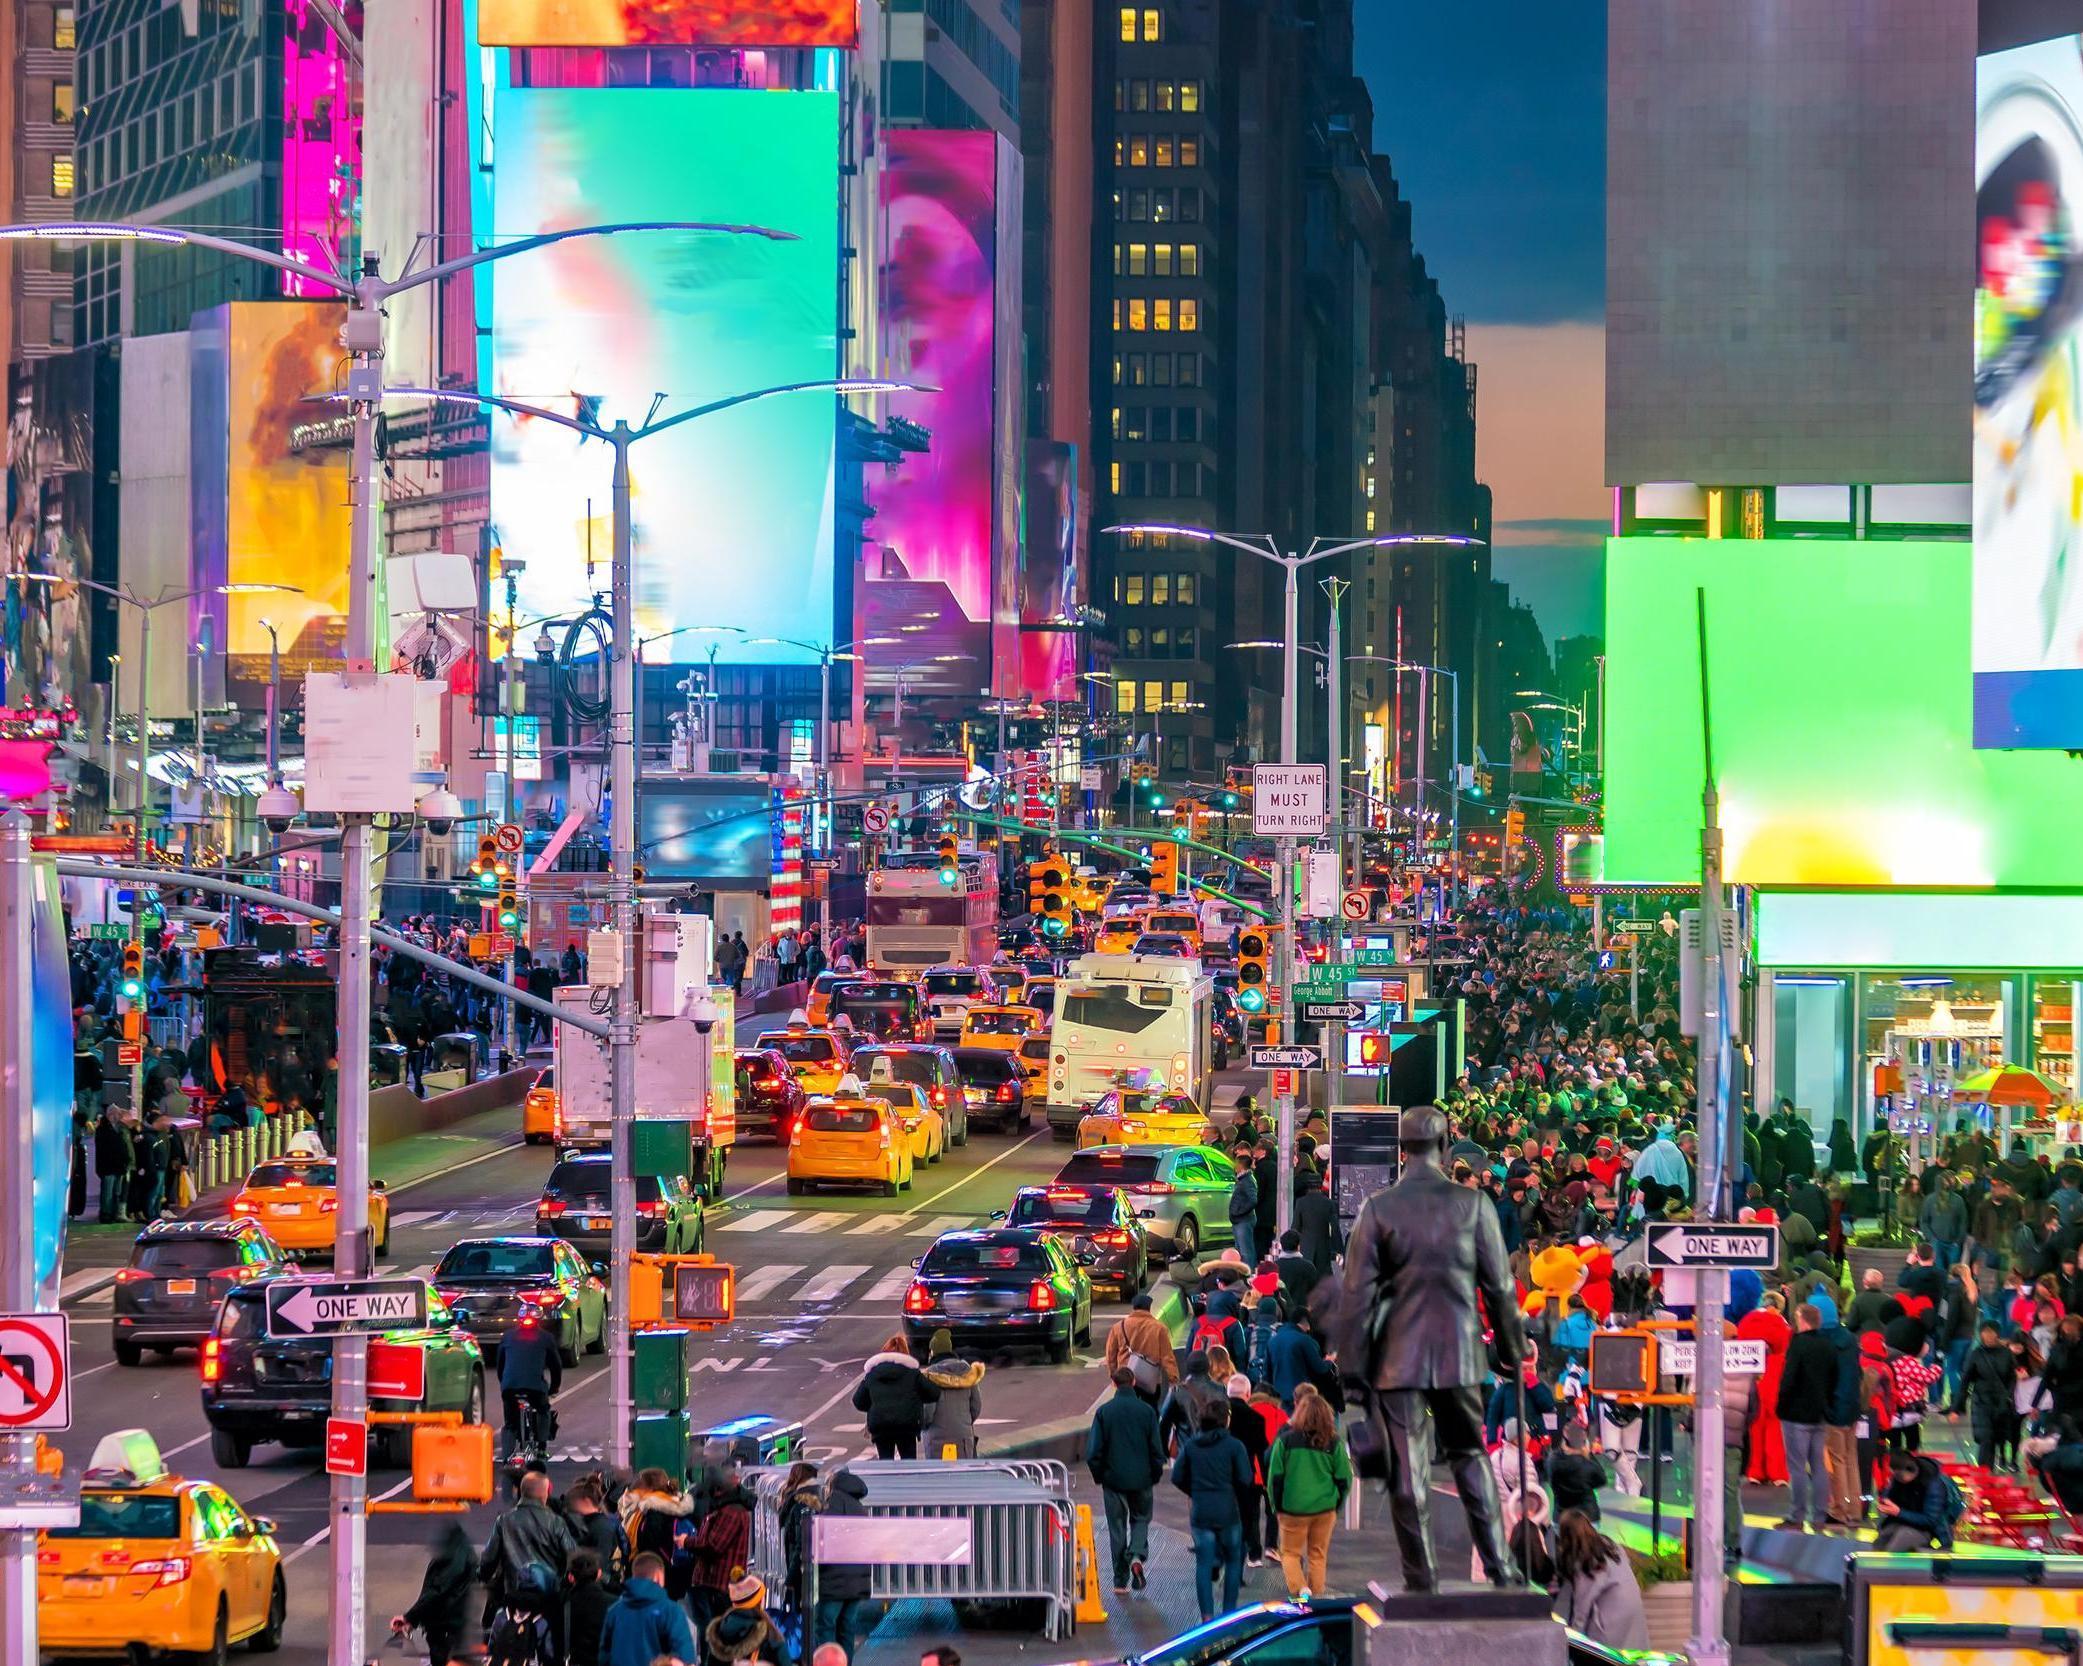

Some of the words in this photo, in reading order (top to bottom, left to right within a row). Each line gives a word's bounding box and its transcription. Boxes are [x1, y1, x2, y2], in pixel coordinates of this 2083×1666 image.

[1257, 774, 1288, 785] RIGHT
[1294, 774, 1322, 785] LANE
[1270, 793, 1308, 807] MUST
[1257, 815, 1284, 826] TURN
[1290, 815, 1322, 826] RIGHT
[93, 926, 101, 937] W
[106, 926, 118, 938] 45
[1357, 950, 1366, 962] W
[1370, 950, 1383, 962] 45
[1312, 968, 1323, 980] W
[1328, 968, 1342, 980] 45
[1347, 968, 1355, 976] St
[1293, 987, 1313, 998] George
[1315, 987, 1333, 996] Abbott
[1313, 1007, 1330, 1015] ONE
[1339, 1007, 1357, 1015] WAY
[1261, 1053, 1281, 1061] ONE
[1290, 1053, 1311, 1061] WAY
[1686, 1238, 1721, 1254] ONE
[1726, 1239, 1763, 1255] WAY
[316, 1298, 358, 1319] ONE
[366, 1295, 409, 1317] WAY
